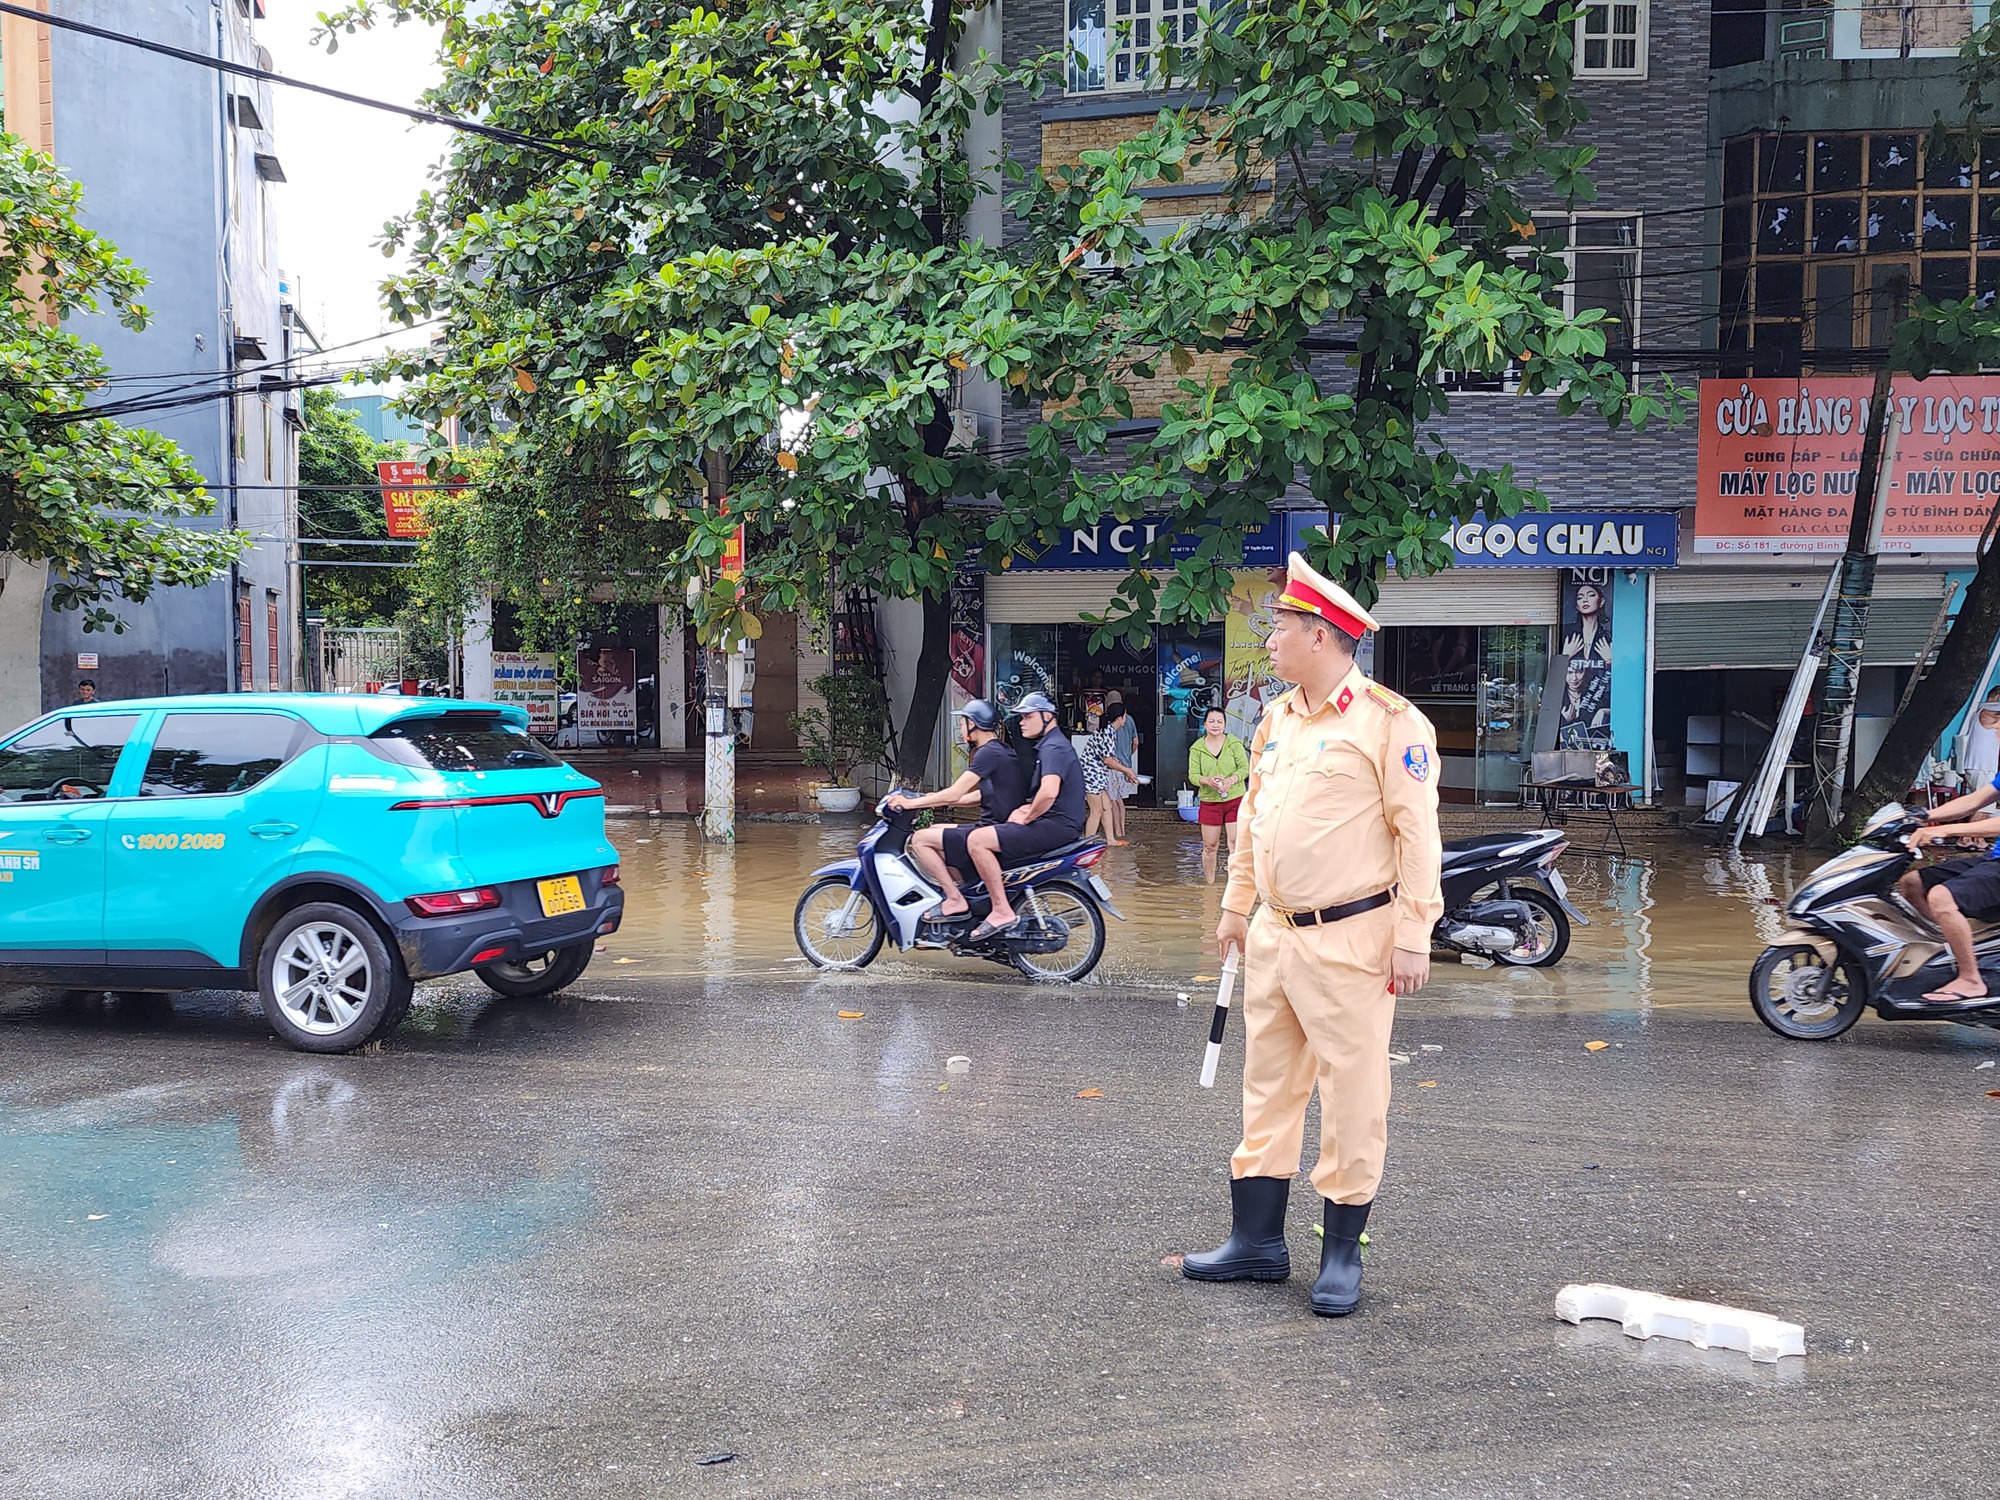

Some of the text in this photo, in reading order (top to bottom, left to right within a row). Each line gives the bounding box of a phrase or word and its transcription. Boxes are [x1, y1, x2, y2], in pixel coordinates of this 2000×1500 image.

[1716, 382, 1771, 436] CỬA
[1776, 387, 1853, 436] HÀNG
[1922, 395, 1975, 445] LỌC
[1979, 395, 2000, 434] T
[1744, 451, 1786, 463] CUNG
[1719, 465, 2000, 501] MÁY LỌC NƯ MÁY LỌC
[1778, 505, 1823, 518] HÀNG
[1827, 507, 1848, 518] ĐA
[1923, 505, 1958, 517] BÌNH
[1781, 521, 1807, 533] GIÁ
[1069, 524, 1160, 561] NCJ
[1440, 521, 1667, 558] GỌC CHÂU NCJ
[1716, 541, 1734, 550] ĐC:
[1884, 541, 1912, 549] TPTQ
[1571, 568, 1608, 587] NCJ
[1040, 630, 1063, 643] STYE
[1570, 659, 1605, 670] STYLE
[526, 664, 543, 679] SỐT
[1442, 683, 1470, 692] TRANG
[580, 709, 594, 718] BIA
[137, 833, 226, 850] 1900 2088
[22, 856, 40, 870] SM
